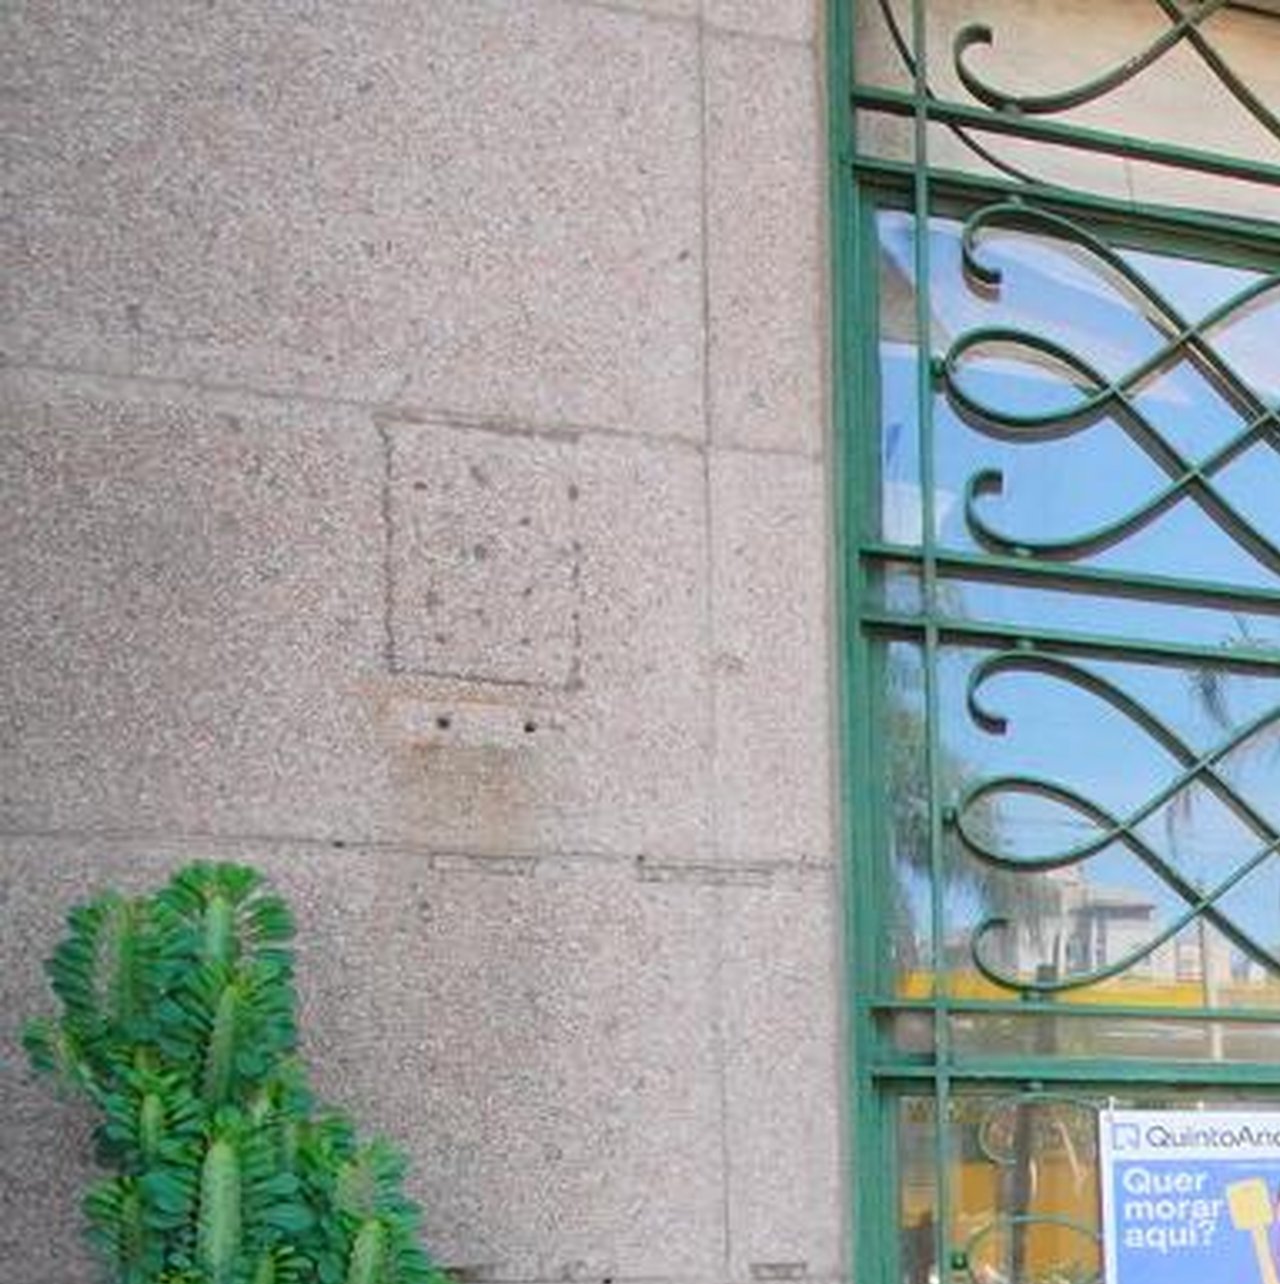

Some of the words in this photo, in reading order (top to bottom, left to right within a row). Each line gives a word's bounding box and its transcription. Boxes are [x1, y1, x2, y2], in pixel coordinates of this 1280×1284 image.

[1122, 1168, 1208, 1194] Quer
[1125, 1199, 1224, 1219] morar
[1125, 1219, 1215, 1252] aqui?
